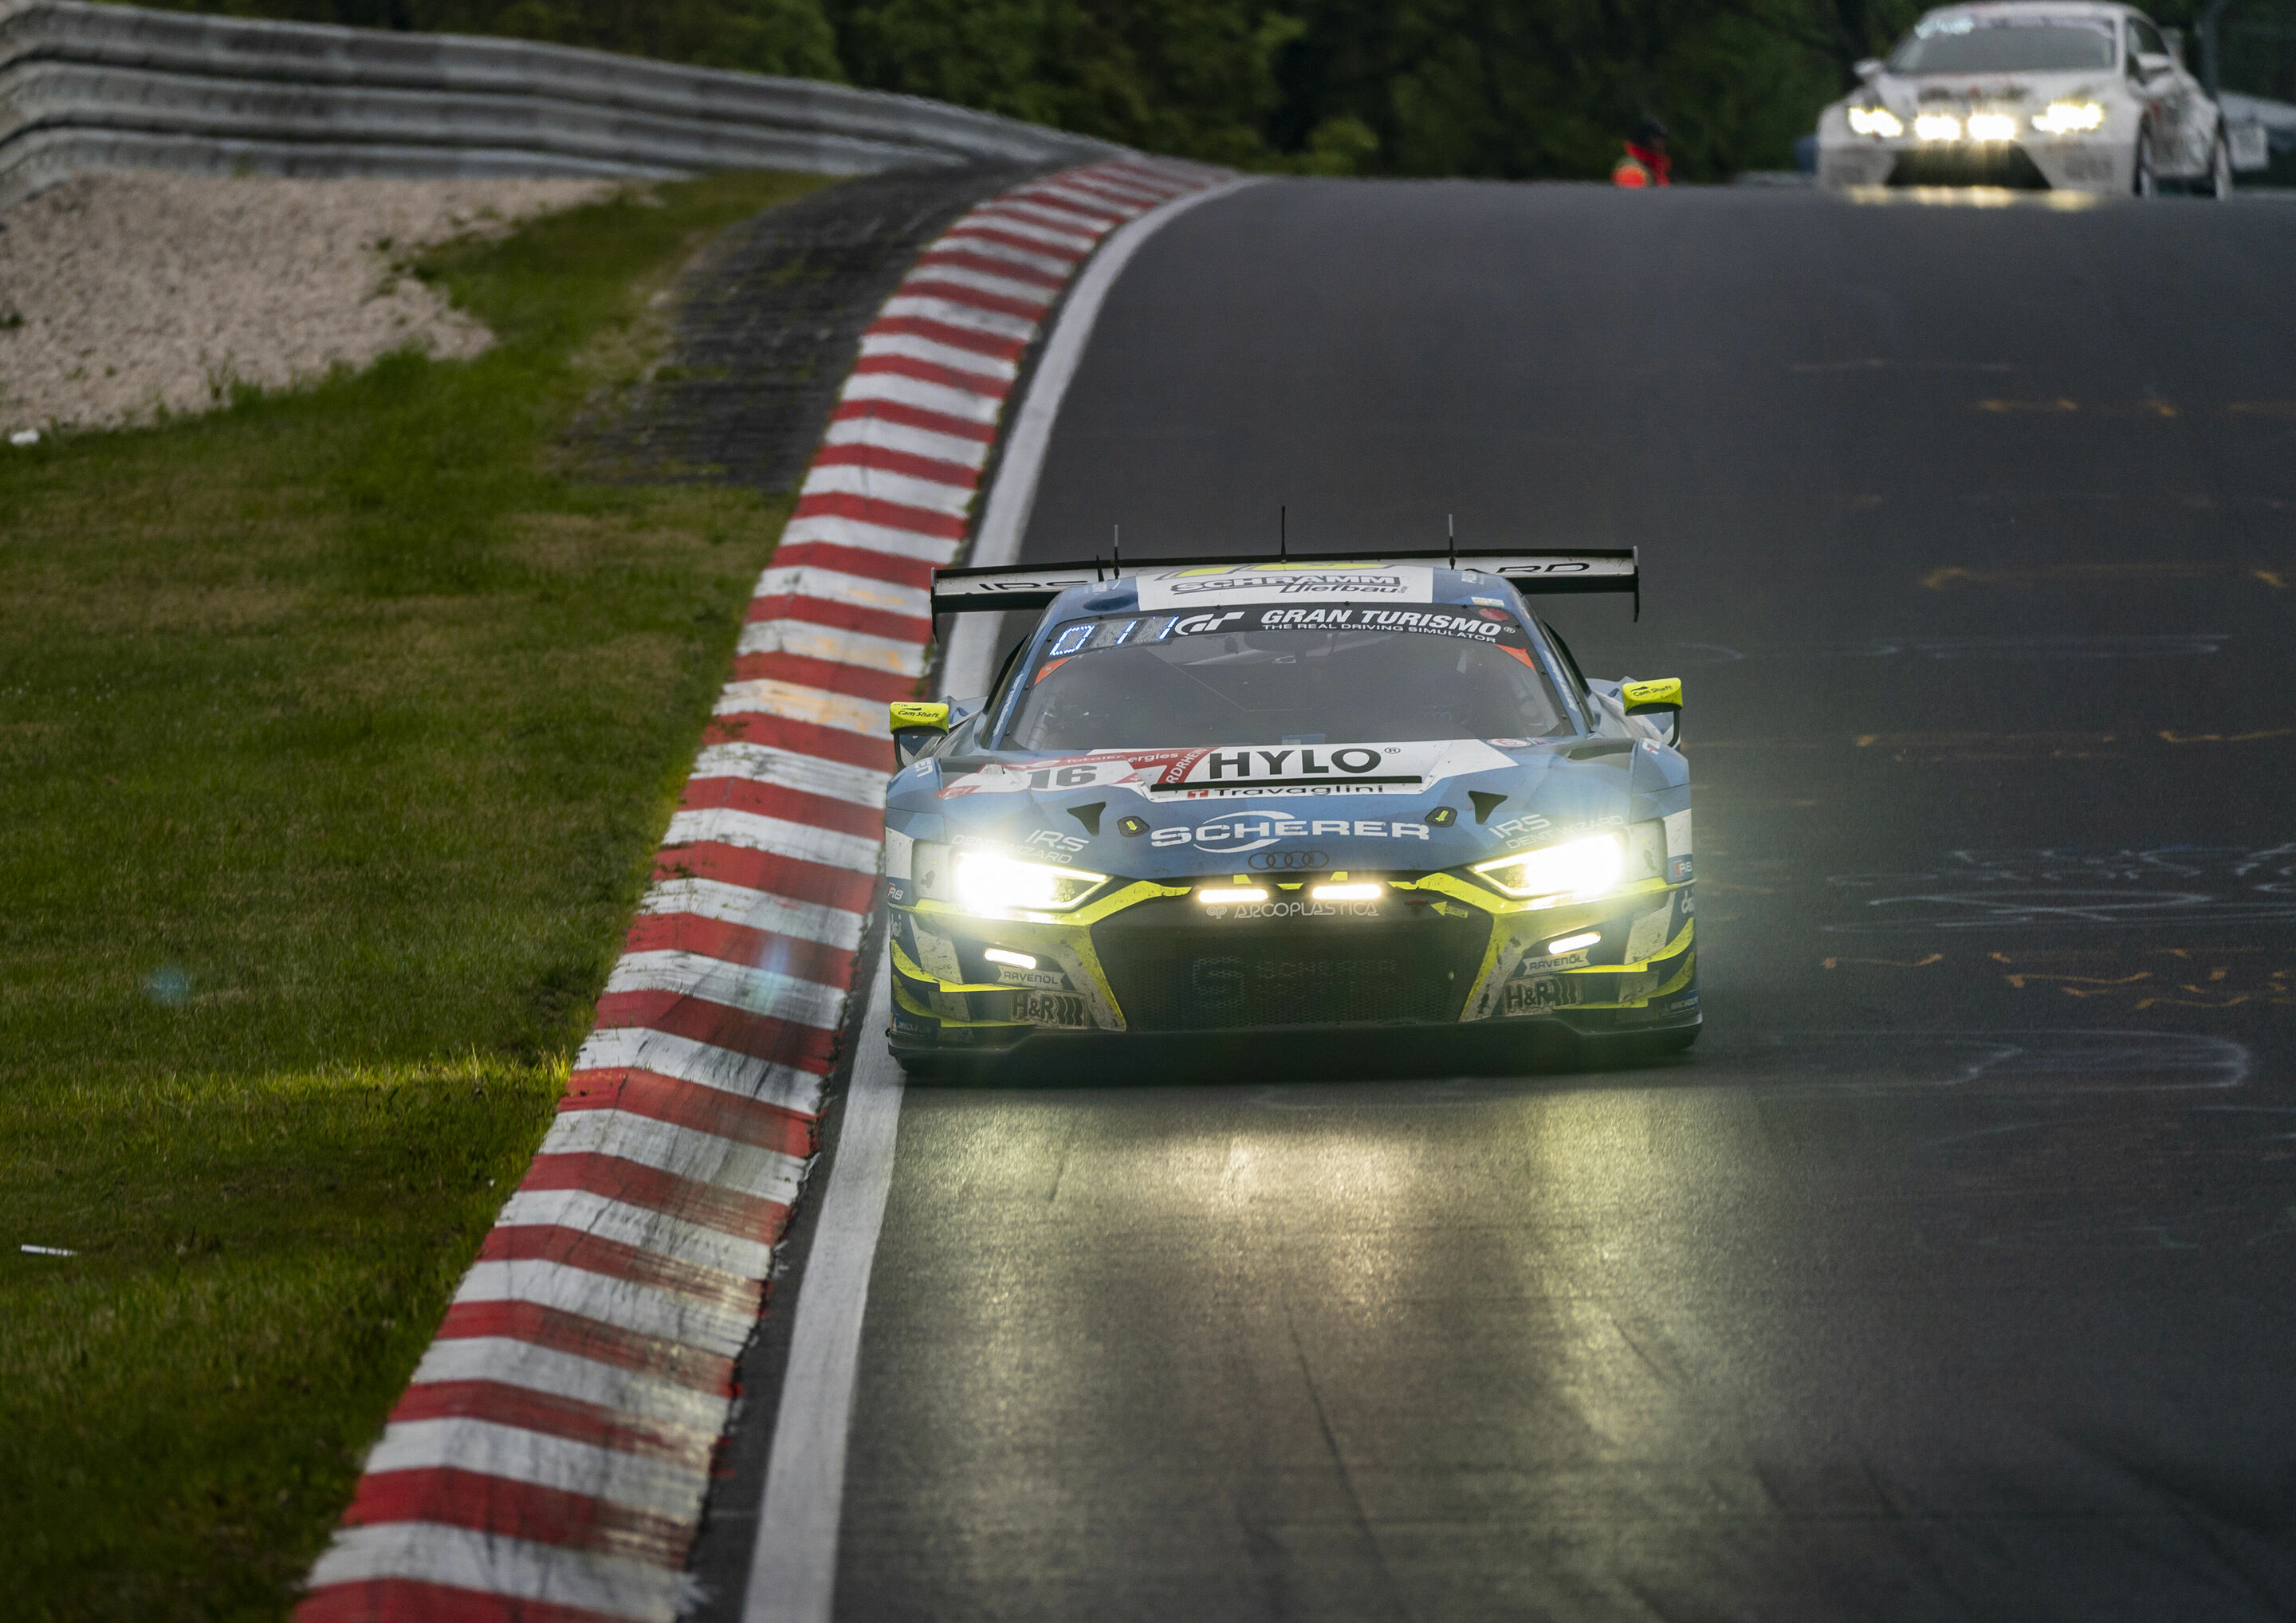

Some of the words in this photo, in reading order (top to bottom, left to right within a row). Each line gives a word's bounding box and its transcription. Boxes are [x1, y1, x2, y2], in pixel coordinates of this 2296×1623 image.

[1170, 575, 1401, 592] SCHRAMM
[1280, 584, 1398, 593] Tiefbau
[1260, 609, 1354, 624] GRAN
[1407, 627, 1496, 643] SIMULATOR
[1028, 765, 1097, 788] 16
[1213, 784, 1383, 796] Travaglini
[1150, 819, 1429, 847] SCHERER
[1488, 813, 1551, 839] IRS
[1025, 829, 1091, 852] IRS
[1505, 830, 1552, 849] DENT
[1234, 902, 1380, 918] ARCOPLASTICA
[1004, 970, 1059, 984] RAVENOL
[1506, 980, 1552, 1012] H&R
[1012, 994, 1054, 1023] H&R
